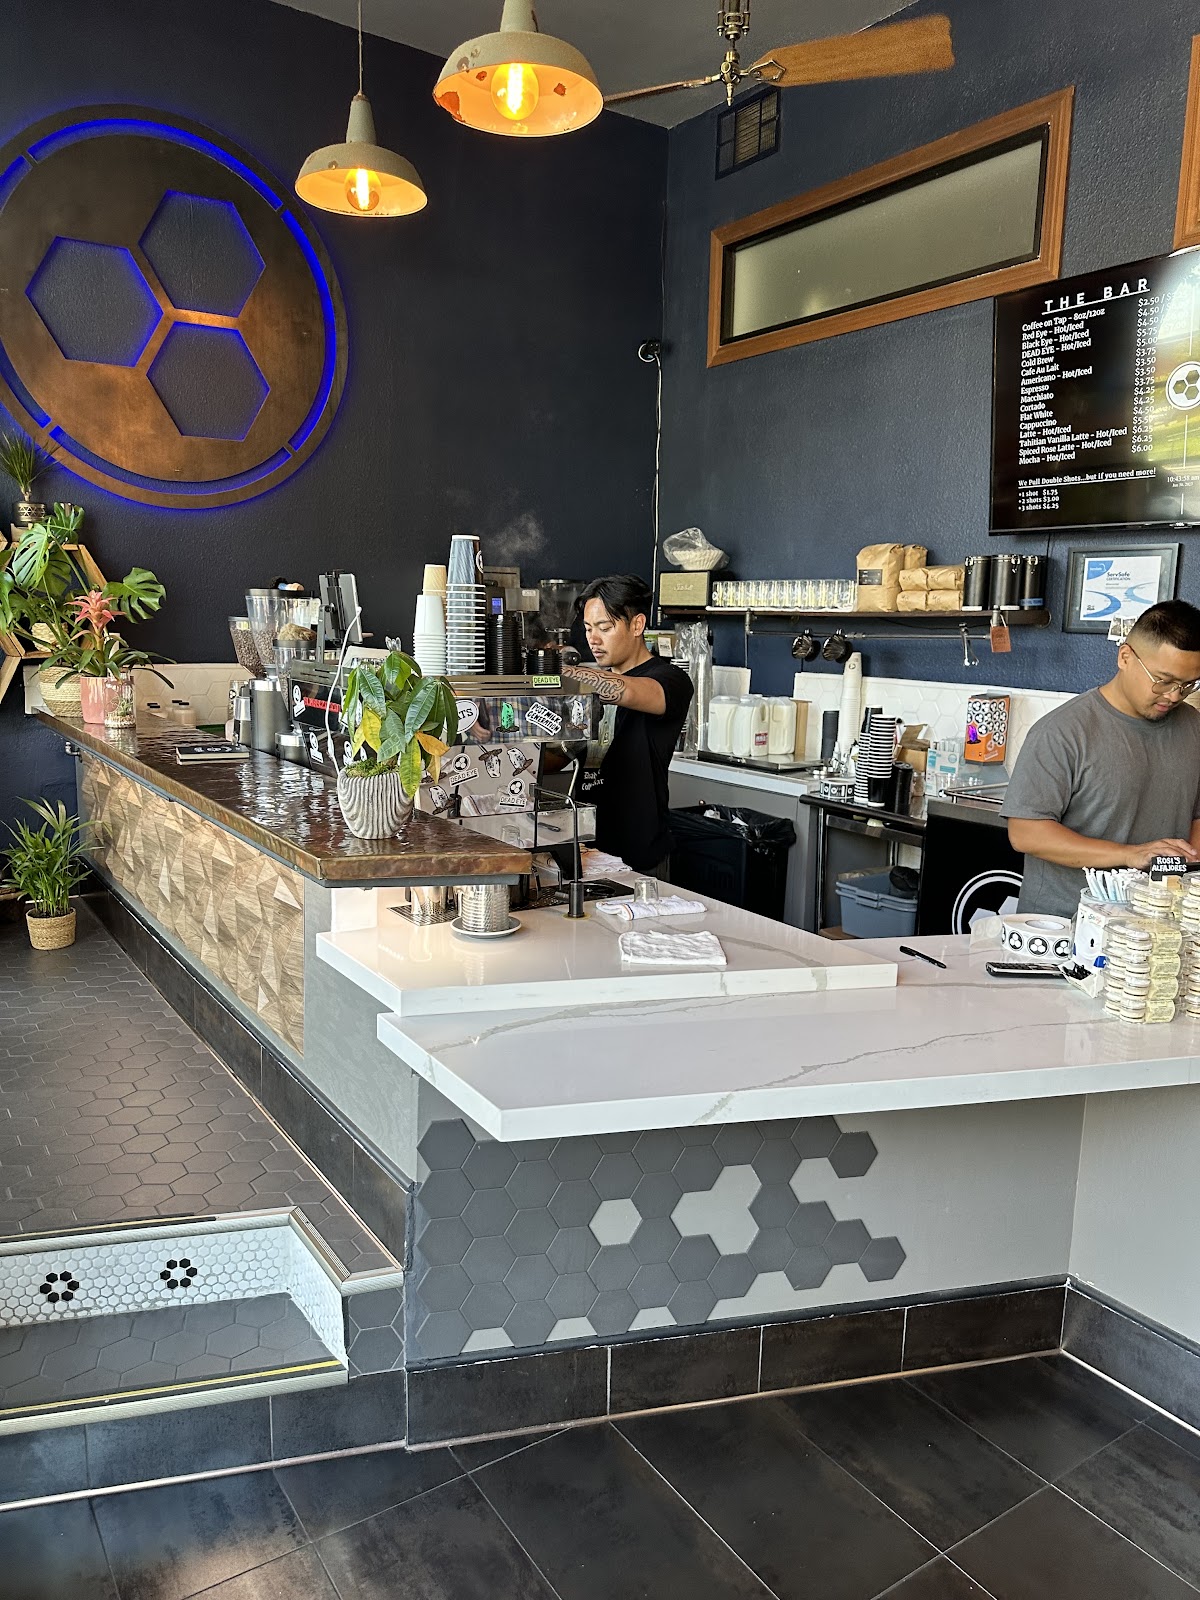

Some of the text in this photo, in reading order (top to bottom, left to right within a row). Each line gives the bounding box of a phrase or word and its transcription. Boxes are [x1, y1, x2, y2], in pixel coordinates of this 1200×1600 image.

[1044, 278, 1148, 311] THE BAR
[1022, 321, 1043, 331] Coffee
[1054, 317, 1067, 325] Tap
[1074, 309, 1105, 320] 8oz/12oz
[1138, 296, 1159, 307] $2.50
[1022, 331, 1034, 340] Red
[1036, 330, 1047, 339] Eye
[1054, 321, 1084, 334] Hot/Iced
[1138, 306, 1159, 317] $4.50
[1022, 340, 1040, 350] Black
[1041, 338, 1052, 347] Eye
[1059, 329, 1089, 342] Hot/Iced
[1137, 317, 1158, 327] $4.50
[1022, 348, 1040, 359] DEAD
[1041, 346, 1055, 355] EYE
[1061, 338, 1091, 351] Hot/Iced
[1137, 327, 1157, 337] $5.75
[1021, 337, 1157, 367] Cold Brew $5.00
[1021, 368, 1035, 376] Cafe
[1046, 363, 1059, 372] Lait
[1136, 347, 1156, 357] $3.75
[1021, 374, 1056, 386] Americano
[1062, 366, 1092, 378] Hot/Iced
[1135, 357, 1156, 366] $3.50
[1021, 366, 1155, 395] Espresso $3.50
[1020, 376, 1155, 403] Macchiato $3.75
[1020, 386, 1155, 412] Cortado $4.25
[1020, 396, 1154, 421] Flat White $4.25
[1020, 406, 1154, 430] Cappuccino $4.50
[1019, 438, 1046, 447] Tahitian
[1047, 434, 1070, 444] Vanilla
[1071, 432, 1089, 441] Latte
[1096, 427, 1127, 438] Hot/Iced
[1132, 425, 1153, 434] $6.25
[1043, 425, 1071, 436] Hot/Iced
[1133, 415, 1153, 424] $5.50
[1019, 447, 1040, 458] Spiced
[1058, 443, 1075, 452] Latte
[1081, 438, 1112, 449] Hot/Iced
[1132, 435, 1152, 444] $6.25
[1019, 456, 1040, 465] Mocha
[1047, 451, 1075, 462] Hot/Iced
[1132, 444, 1153, 453] $6.00
[1136, 467, 1156, 476] more!
[528, 711, 559, 731] GENERATION
[544, 711, 560, 723] MILK
[451, 769, 478, 783] DEAD EYE
[1156, 856, 1180, 864] ROSI'S
